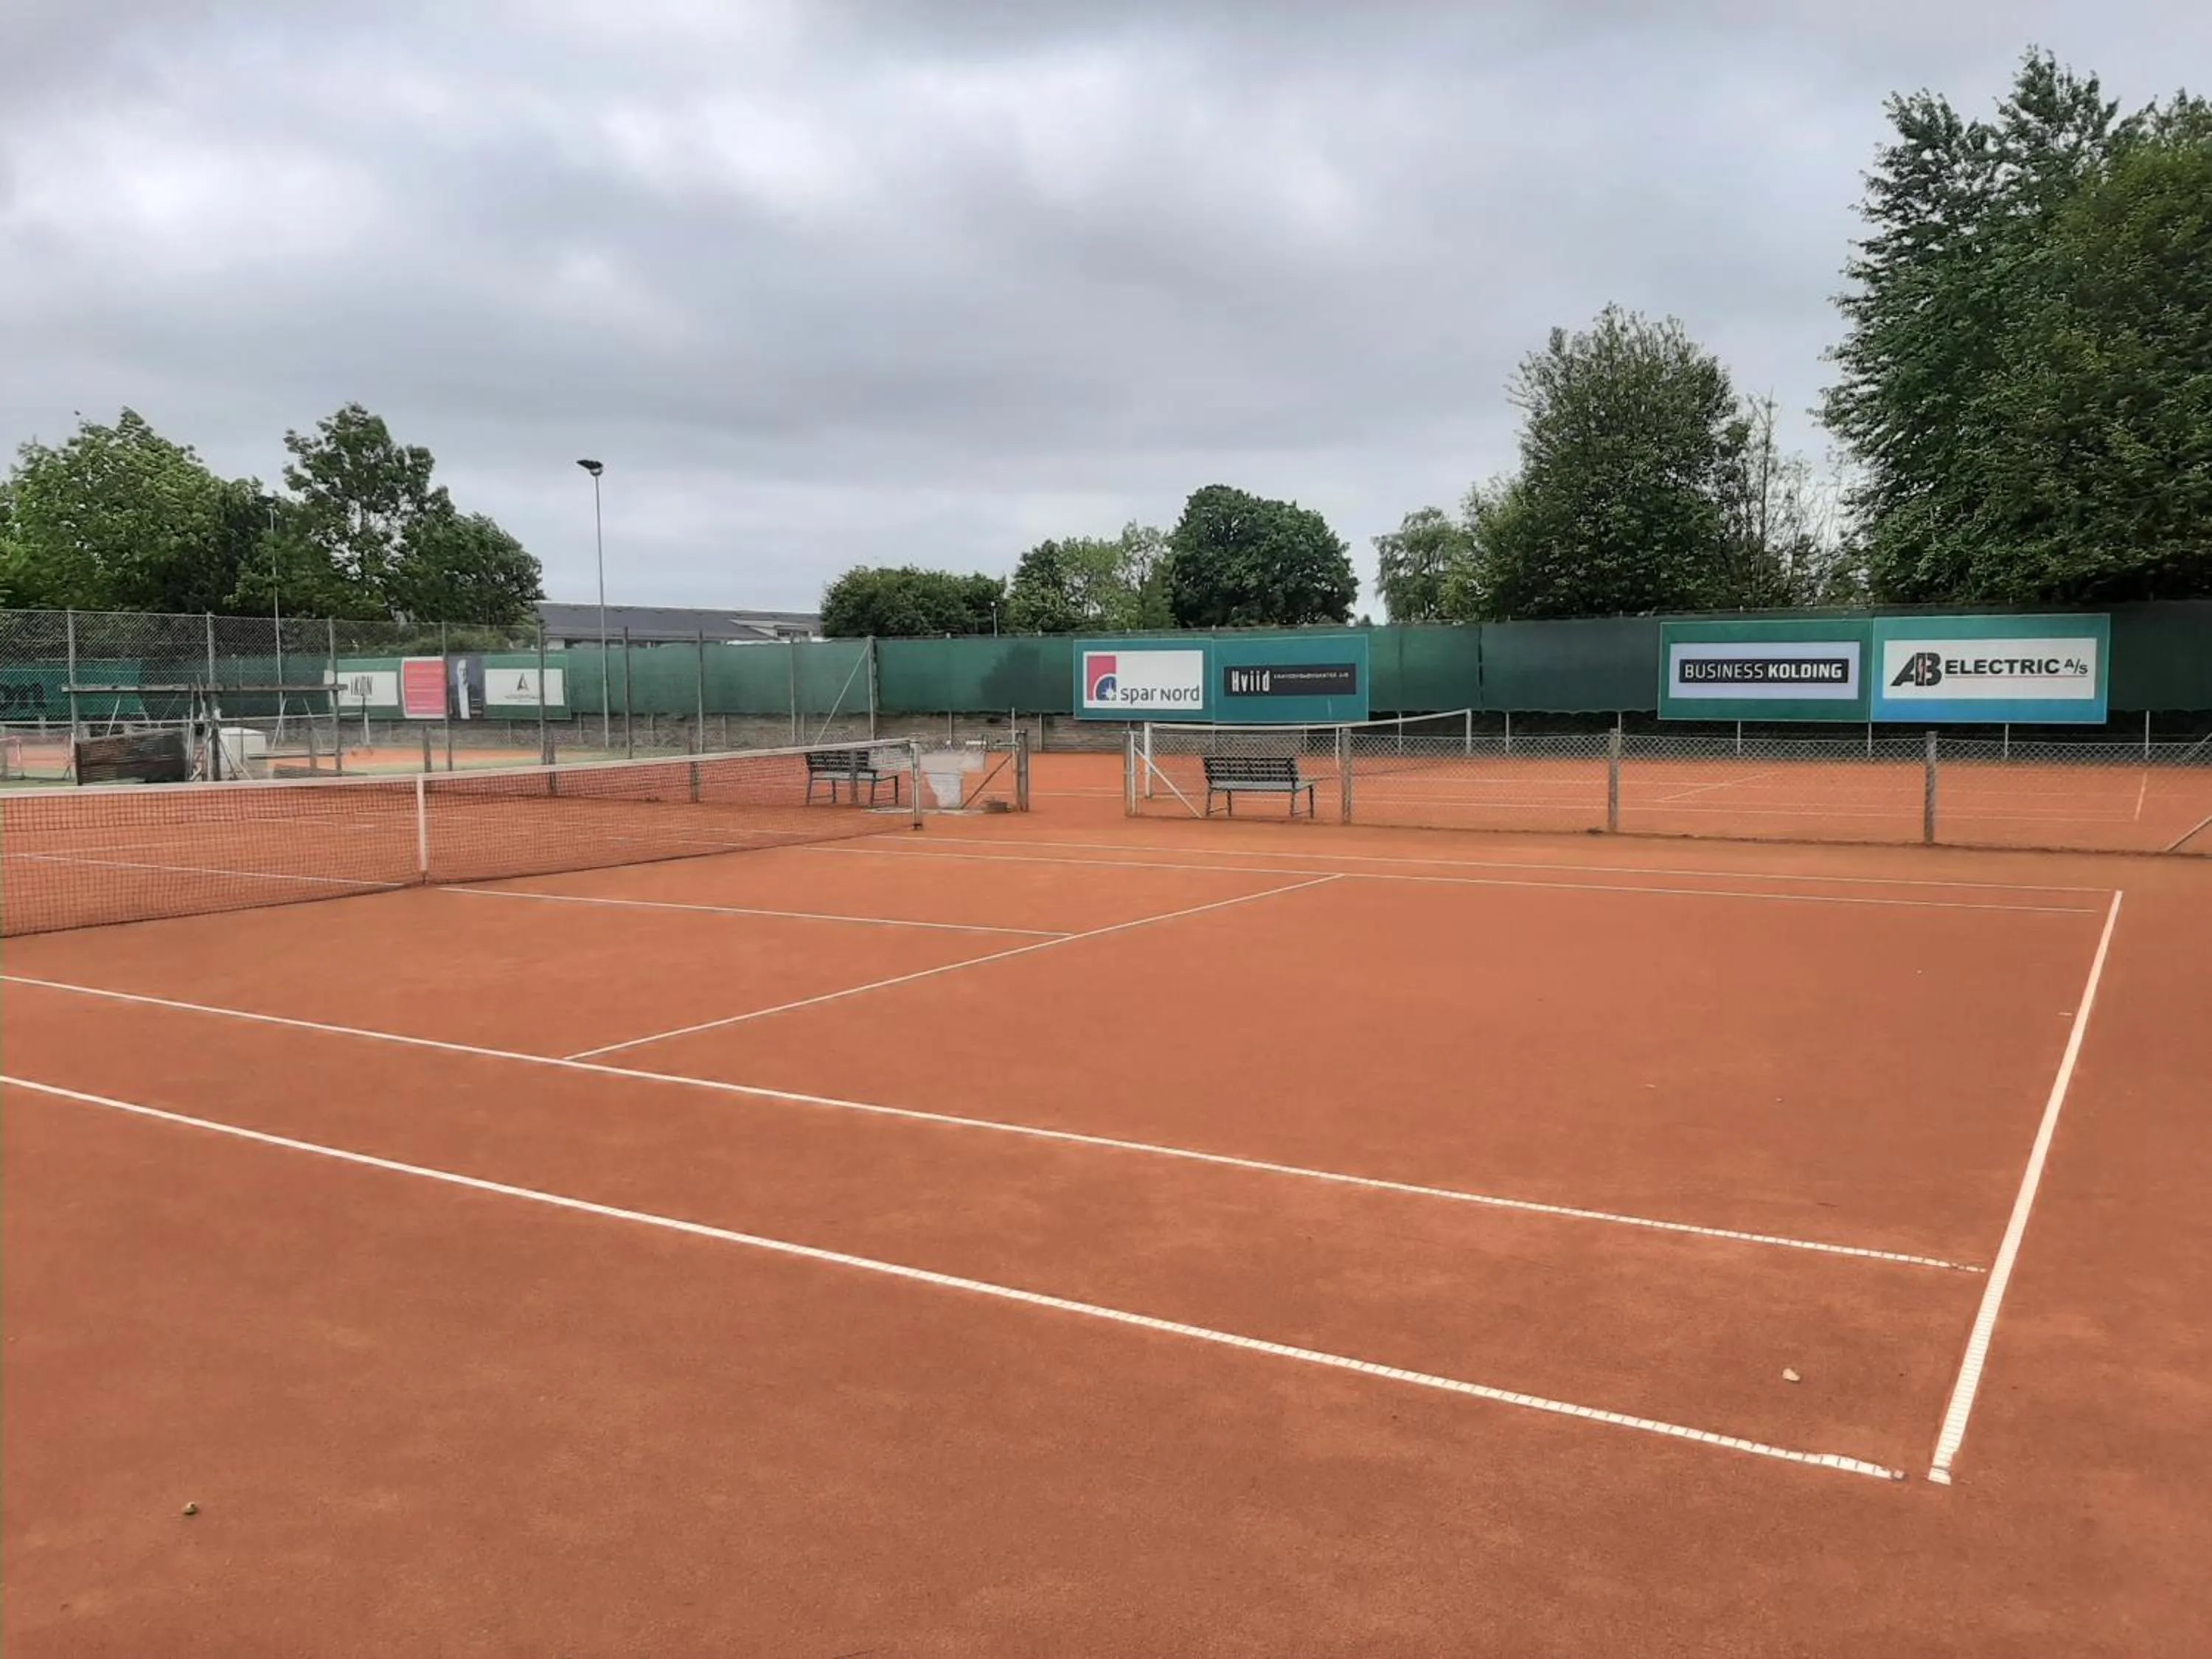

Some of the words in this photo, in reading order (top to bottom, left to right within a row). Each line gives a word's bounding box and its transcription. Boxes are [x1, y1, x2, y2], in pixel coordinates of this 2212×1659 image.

[1684, 663, 1763, 679] BUSINESS
[1767, 663, 1843, 679] KOLDING
[1944, 658, 2060, 675] ELECTRIC
[1231, 669, 1270, 692] Hviid
